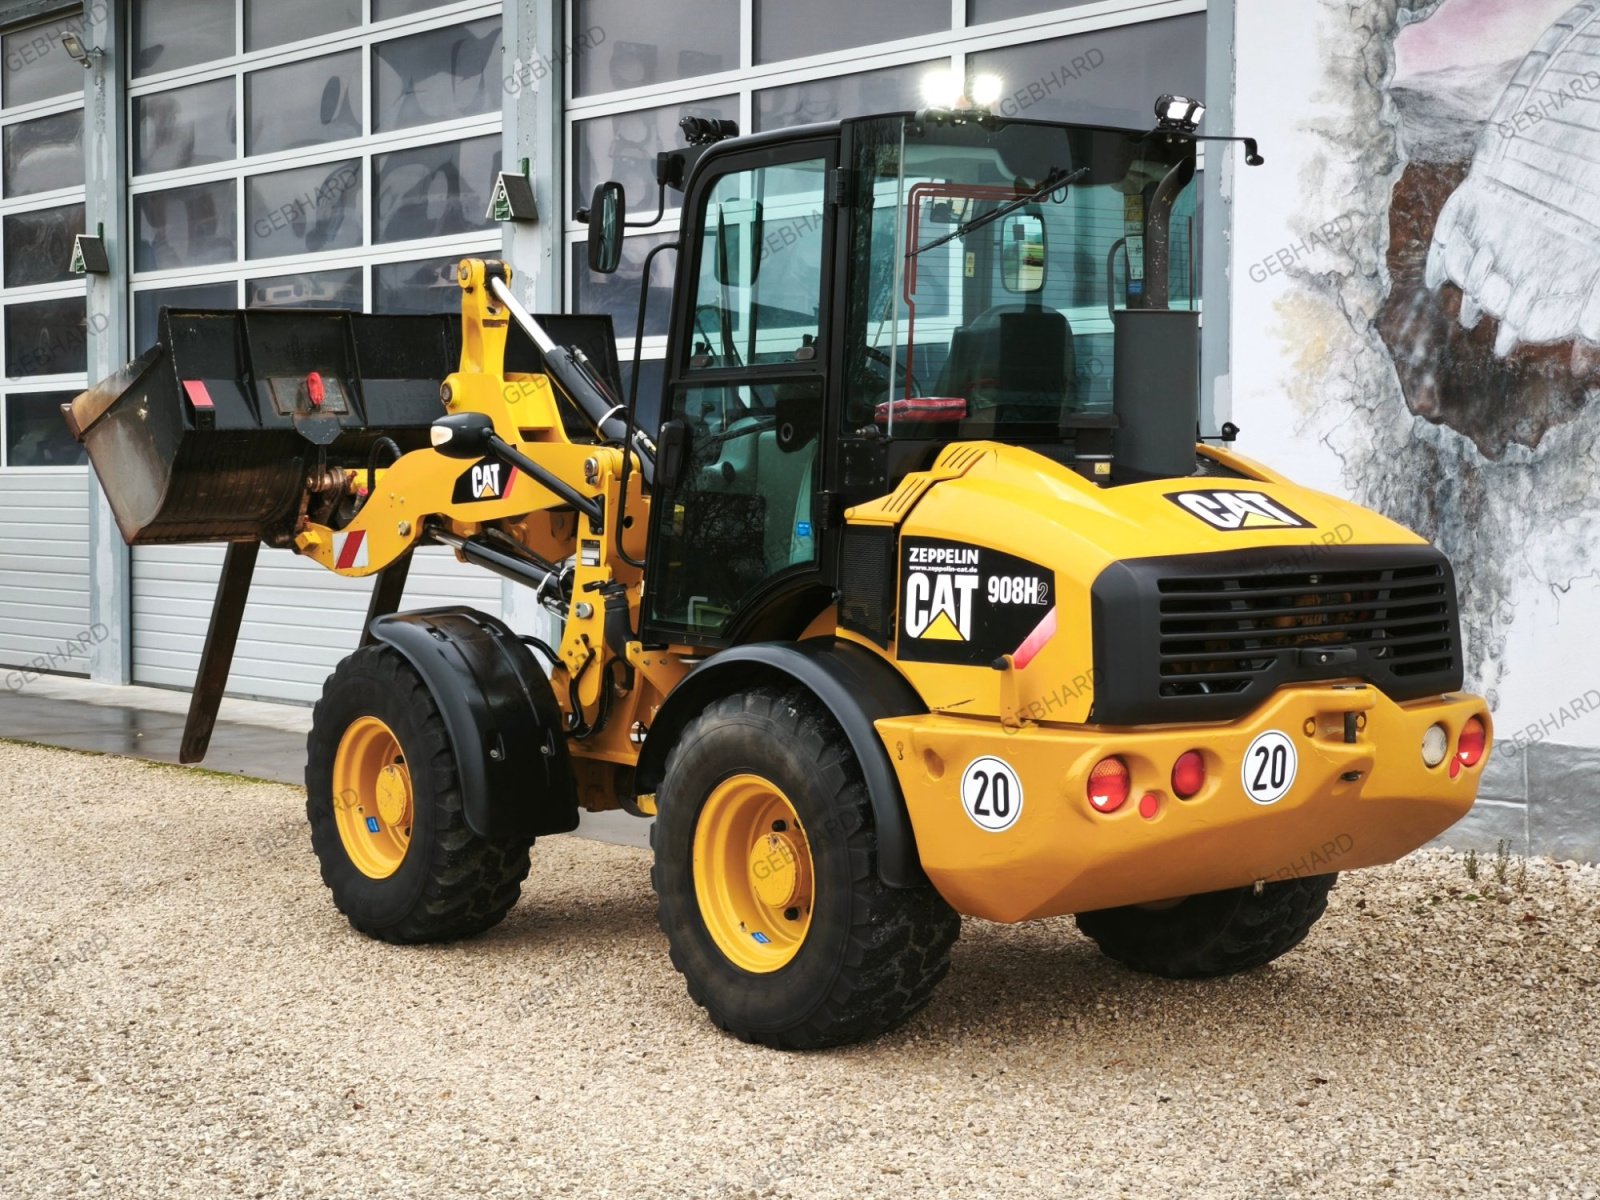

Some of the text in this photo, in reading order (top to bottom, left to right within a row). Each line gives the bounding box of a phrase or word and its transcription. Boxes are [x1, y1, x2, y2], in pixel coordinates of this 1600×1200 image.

[471, 463, 500, 499] CAT
[1177, 492, 1303, 529] CAT
[909, 547, 979, 564] ZEPPELIN
[909, 565, 978, 573] www.zeppelin-cat.de
[905, 572, 979, 642] CAT
[1252, 744, 1287, 791] 20
[973, 770, 1010, 818] 20
